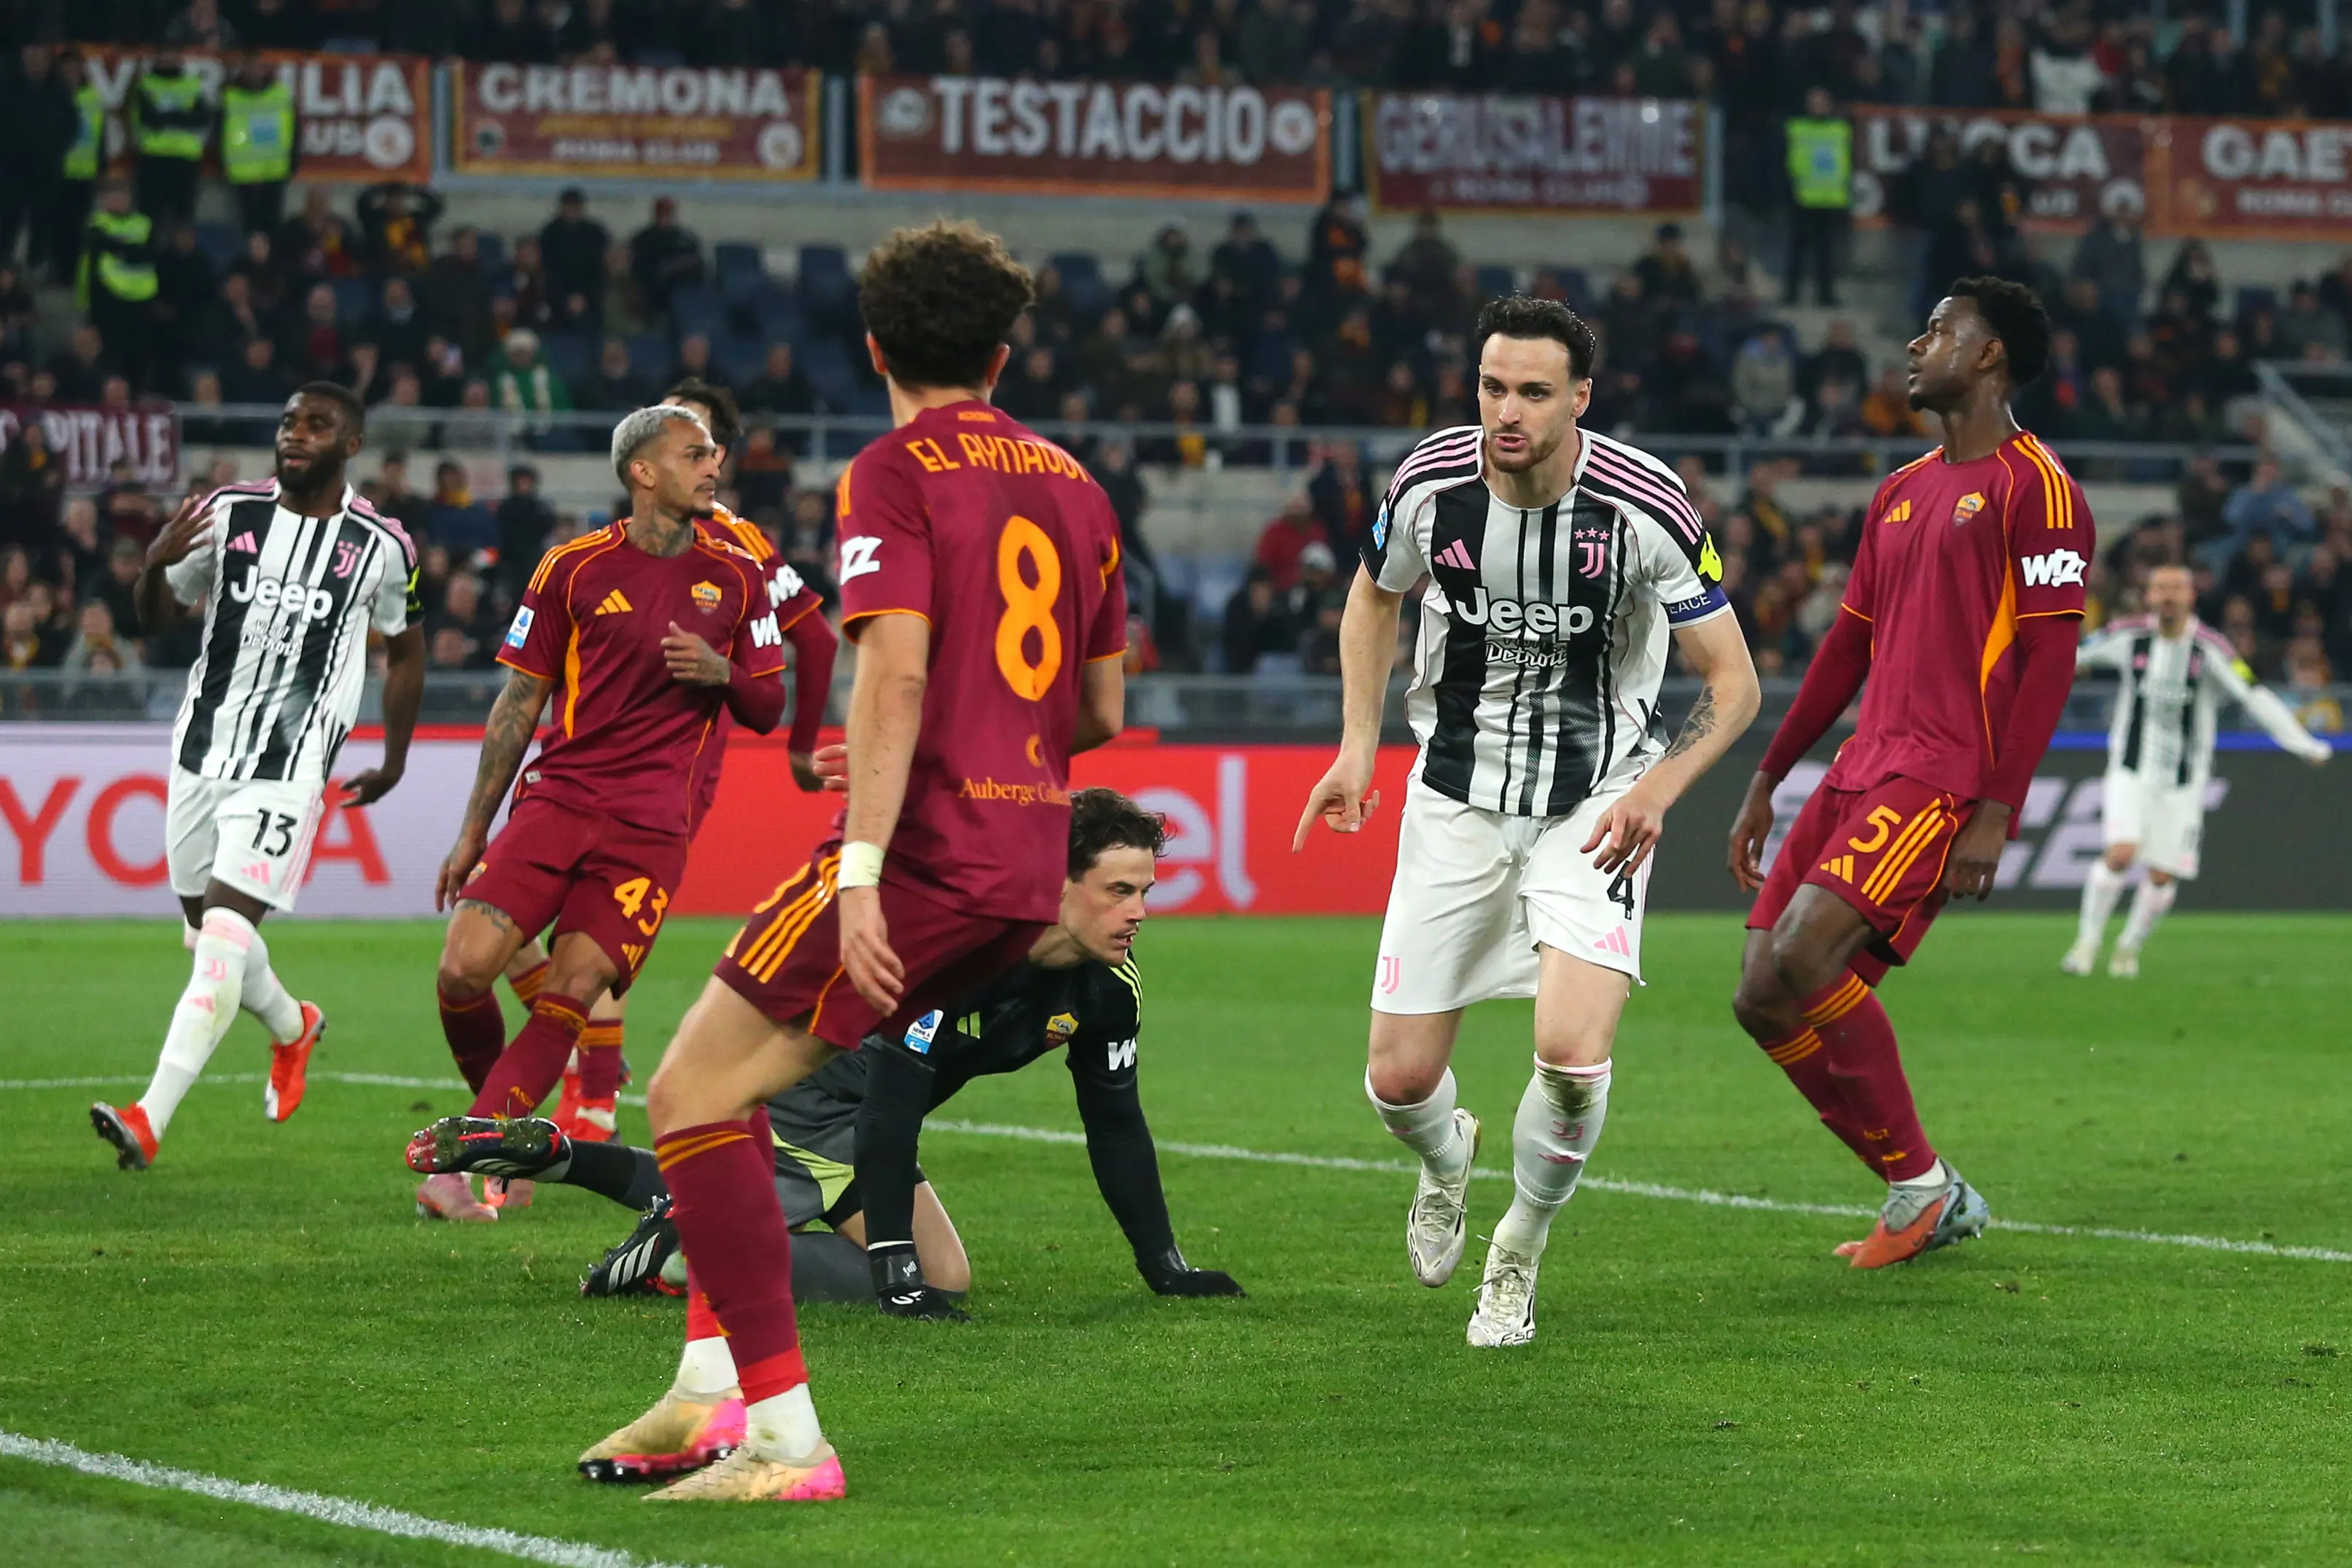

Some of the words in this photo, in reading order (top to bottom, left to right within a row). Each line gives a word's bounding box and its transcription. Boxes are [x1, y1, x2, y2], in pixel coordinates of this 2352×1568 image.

[478, 62, 790, 115] CREMONA
[931, 77, 1266, 164] TESTACCIO
[0, 410, 174, 483] PITALE
[906, 437, 961, 472] EL
[230, 565, 334, 623] Jeep
[995, 515, 1062, 701] 8
[1455, 587, 1594, 641] Jeep
[1668, 594, 1712, 615] EACE
[1486, 641, 1568, 668] Detroit
[959, 777, 1036, 806] Auberge
[0, 774, 391, 888] YOA
[252, 808, 298, 858] 13
[1847, 805, 1903, 853] 5
[613, 876, 669, 937] 43
[1606, 860, 1635, 921] 4
